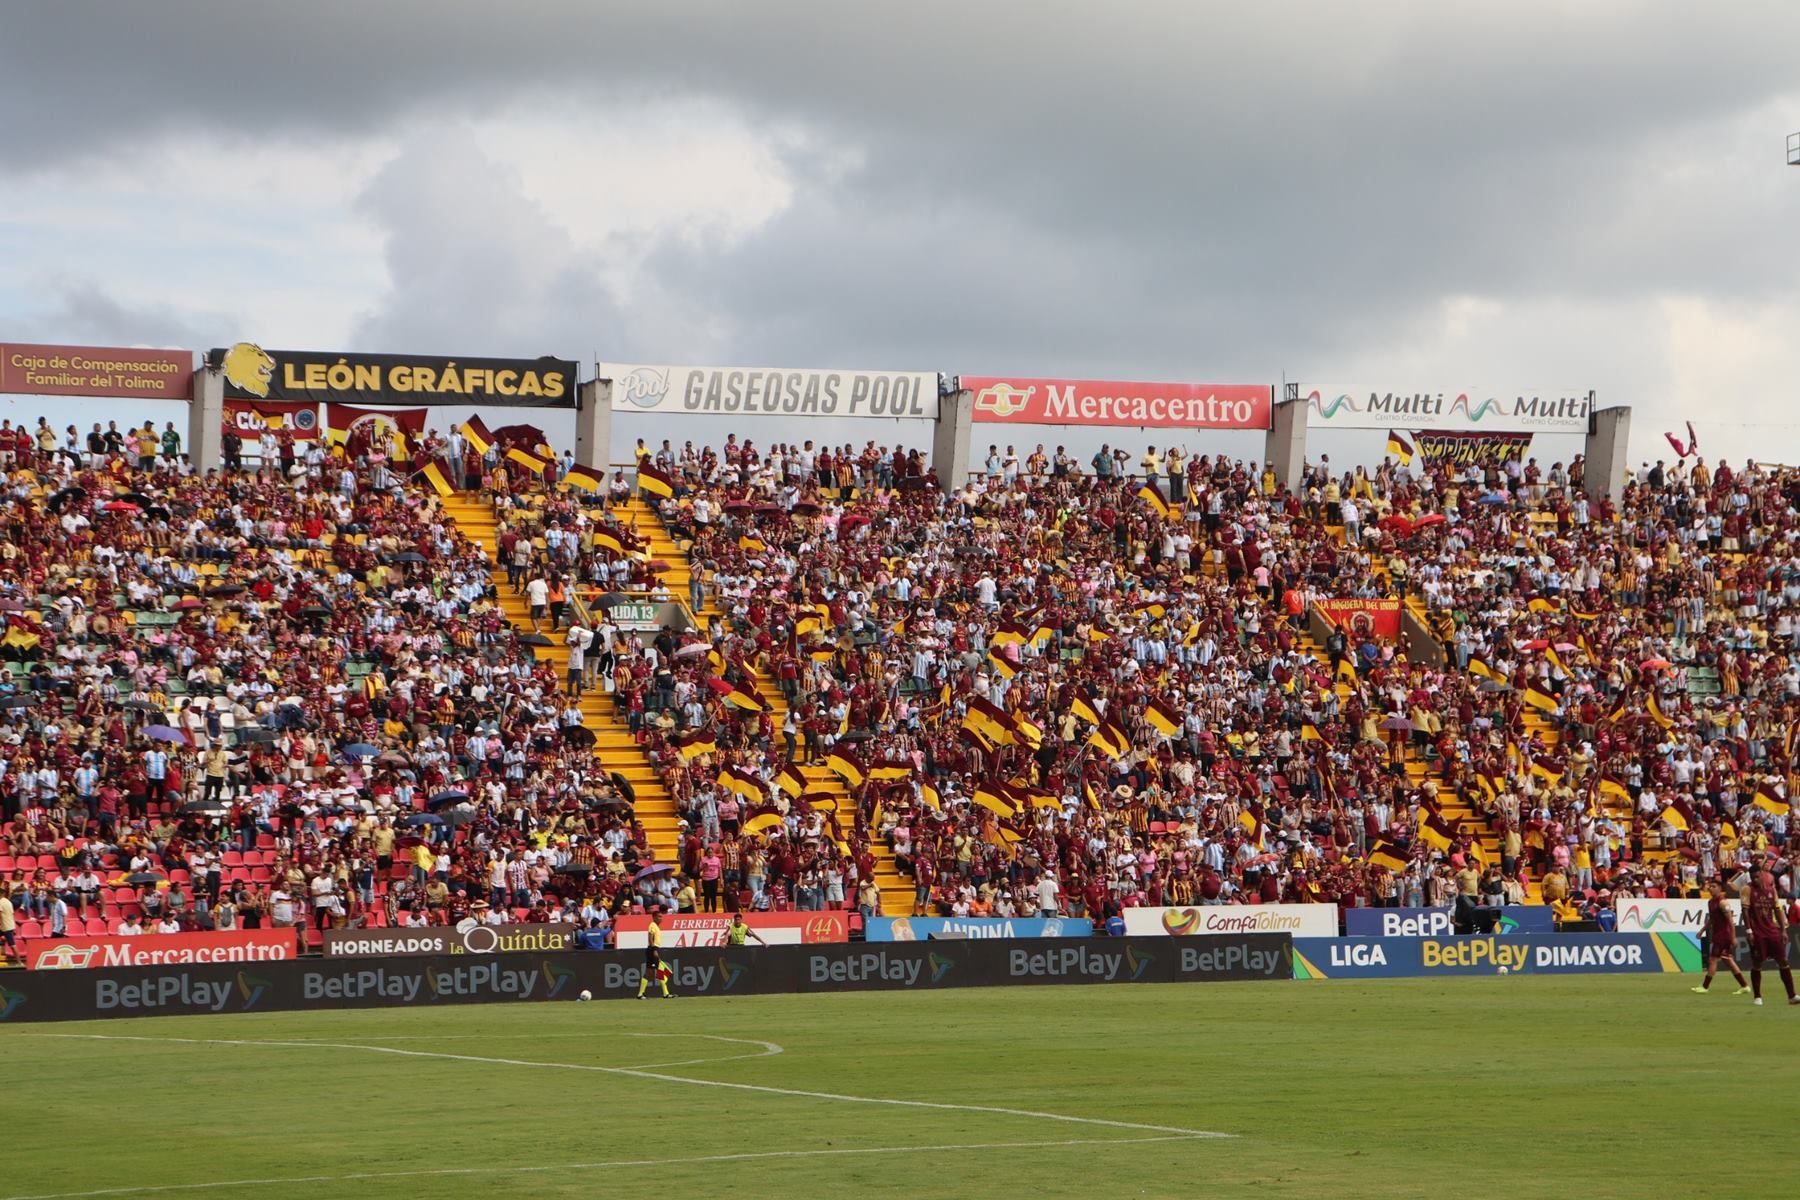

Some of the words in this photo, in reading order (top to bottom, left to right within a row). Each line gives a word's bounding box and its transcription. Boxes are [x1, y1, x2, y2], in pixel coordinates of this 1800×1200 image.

[11, 354, 46, 371] Caja
[49, 356, 68, 369] de
[71, 356, 179, 374] Compensación
[284, 358, 381, 391] LEÓN
[388, 361, 564, 398] GRÁFICAS
[26, 371, 86, 387] Familiar
[90, 374, 112, 388] del
[115, 375, 165, 390] Tolima
[619, 368, 671, 402] Pool
[684, 370, 841, 413] GASEOSAS
[848, 375, 924, 415] POOL
[1043, 385, 1252, 423] Mercacentro
[1366, 392, 1444, 415] Multi
[1513, 396, 1588, 418] Multi
[641, 605, 654, 619] 13
[672, 918, 735, 930] FERRETER
[813, 918, 832, 935] 44
[1206, 911, 1301, 932] ComfaTolima
[1383, 911, 1454, 936] BetPl
[103, 941, 286, 967] Mercacentro
[331, 938, 443, 955] HORNEADOS
[450, 942, 464, 955] La
[464, 926, 564, 954] Quinta
[1331, 945, 1387, 967] LIGA
[1423, 937, 1529, 971] BetPlay
[1536, 945, 1643, 968] DIMAYOR
[810, 950, 922, 986] BetPlay
[1010, 946, 1122, 981] BetPlay
[1181, 944, 1280, 975] BetPlay
[303, 968, 421, 1001] BetPlay
[604, 958, 715, 992] Belay
[96, 973, 232, 1011] BetPlay
